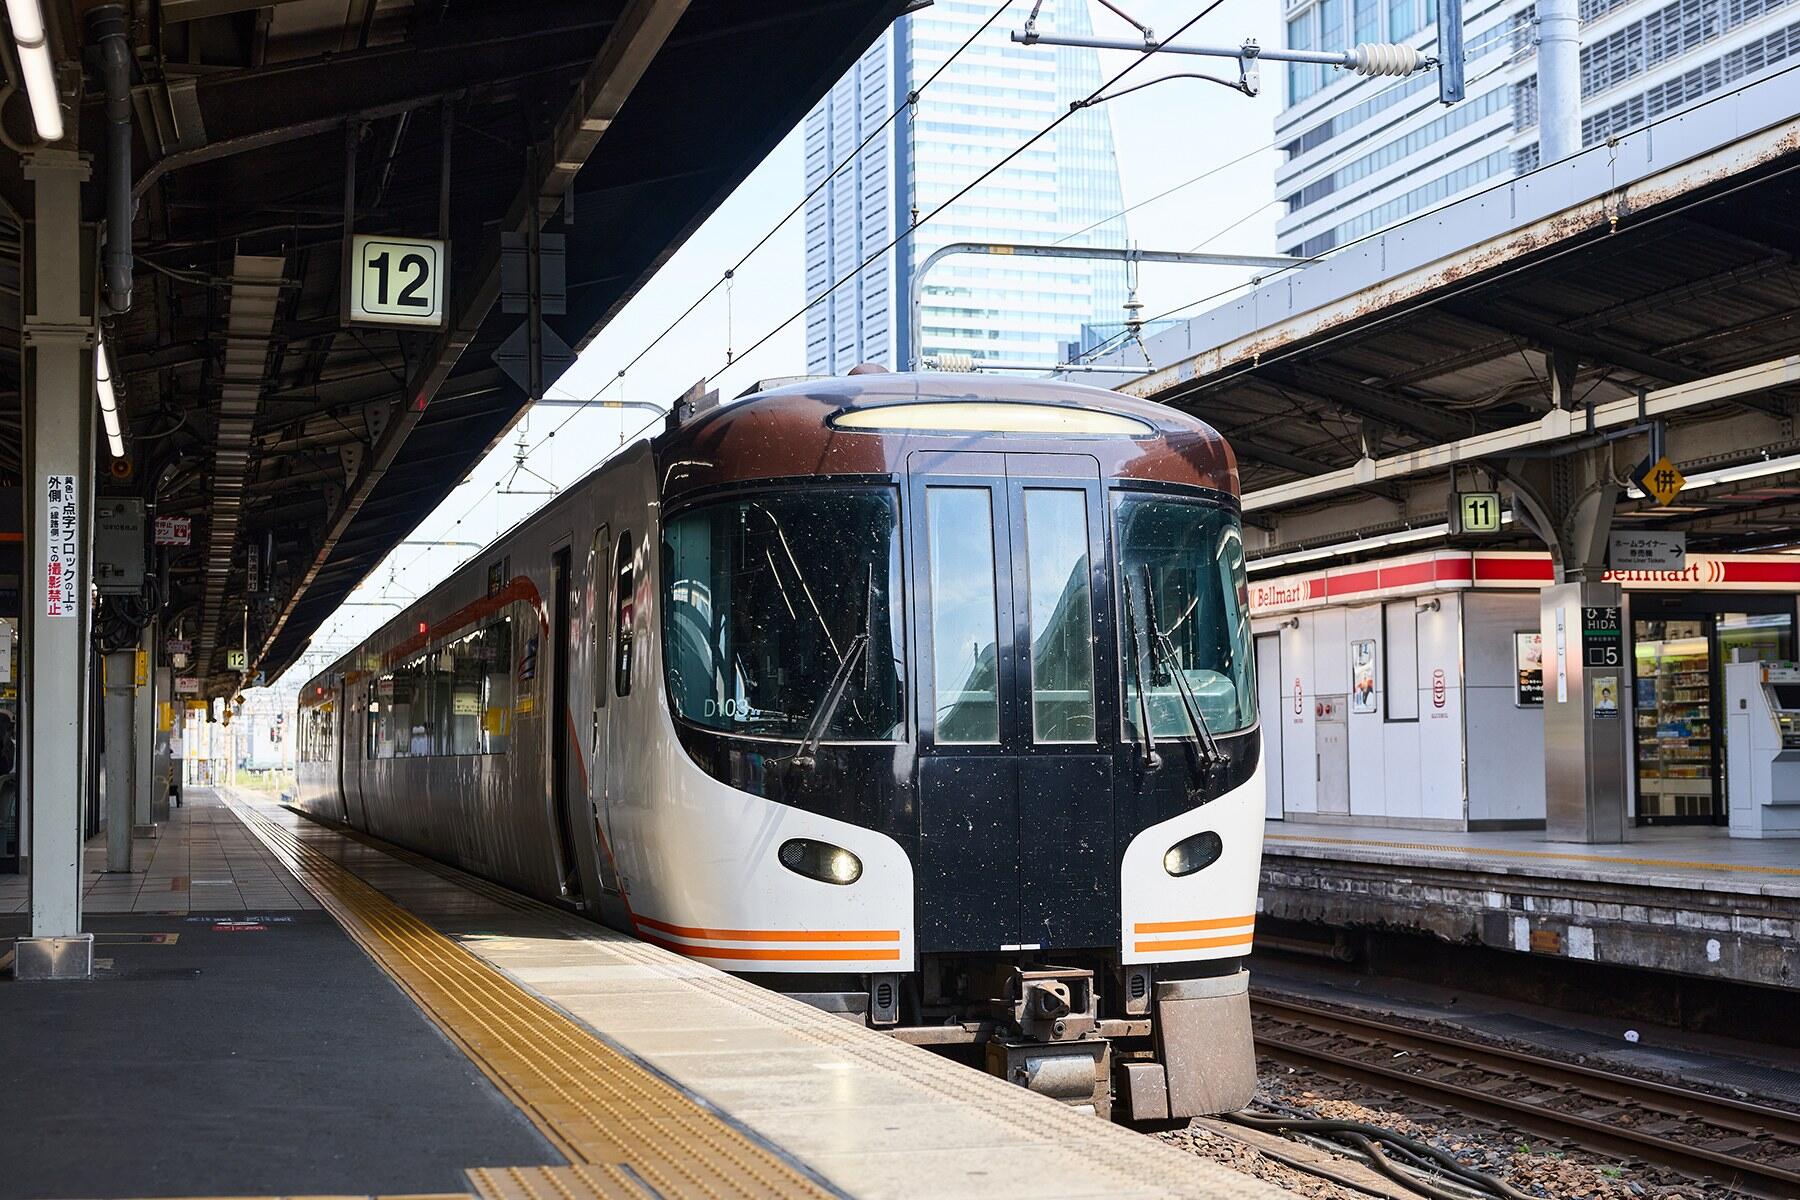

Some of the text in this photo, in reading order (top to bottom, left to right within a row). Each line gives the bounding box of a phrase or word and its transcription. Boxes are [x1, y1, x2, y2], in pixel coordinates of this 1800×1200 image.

[368, 251, 430, 308] 12
[1654, 469, 1676, 494] 併
[1468, 500, 1489, 526] 11
[62, 476, 76, 612] 黄色い点字ブロックの上や
[1615, 540, 1667, 548] ホームライナー
[1257, 583, 1300, 607] Bellmart
[1586, 608, 1617, 619] ひだ
[1587, 620, 1617, 630] HIDA
[231, 653, 244, 666] 12
[1605, 646, 1618, 665] 5
